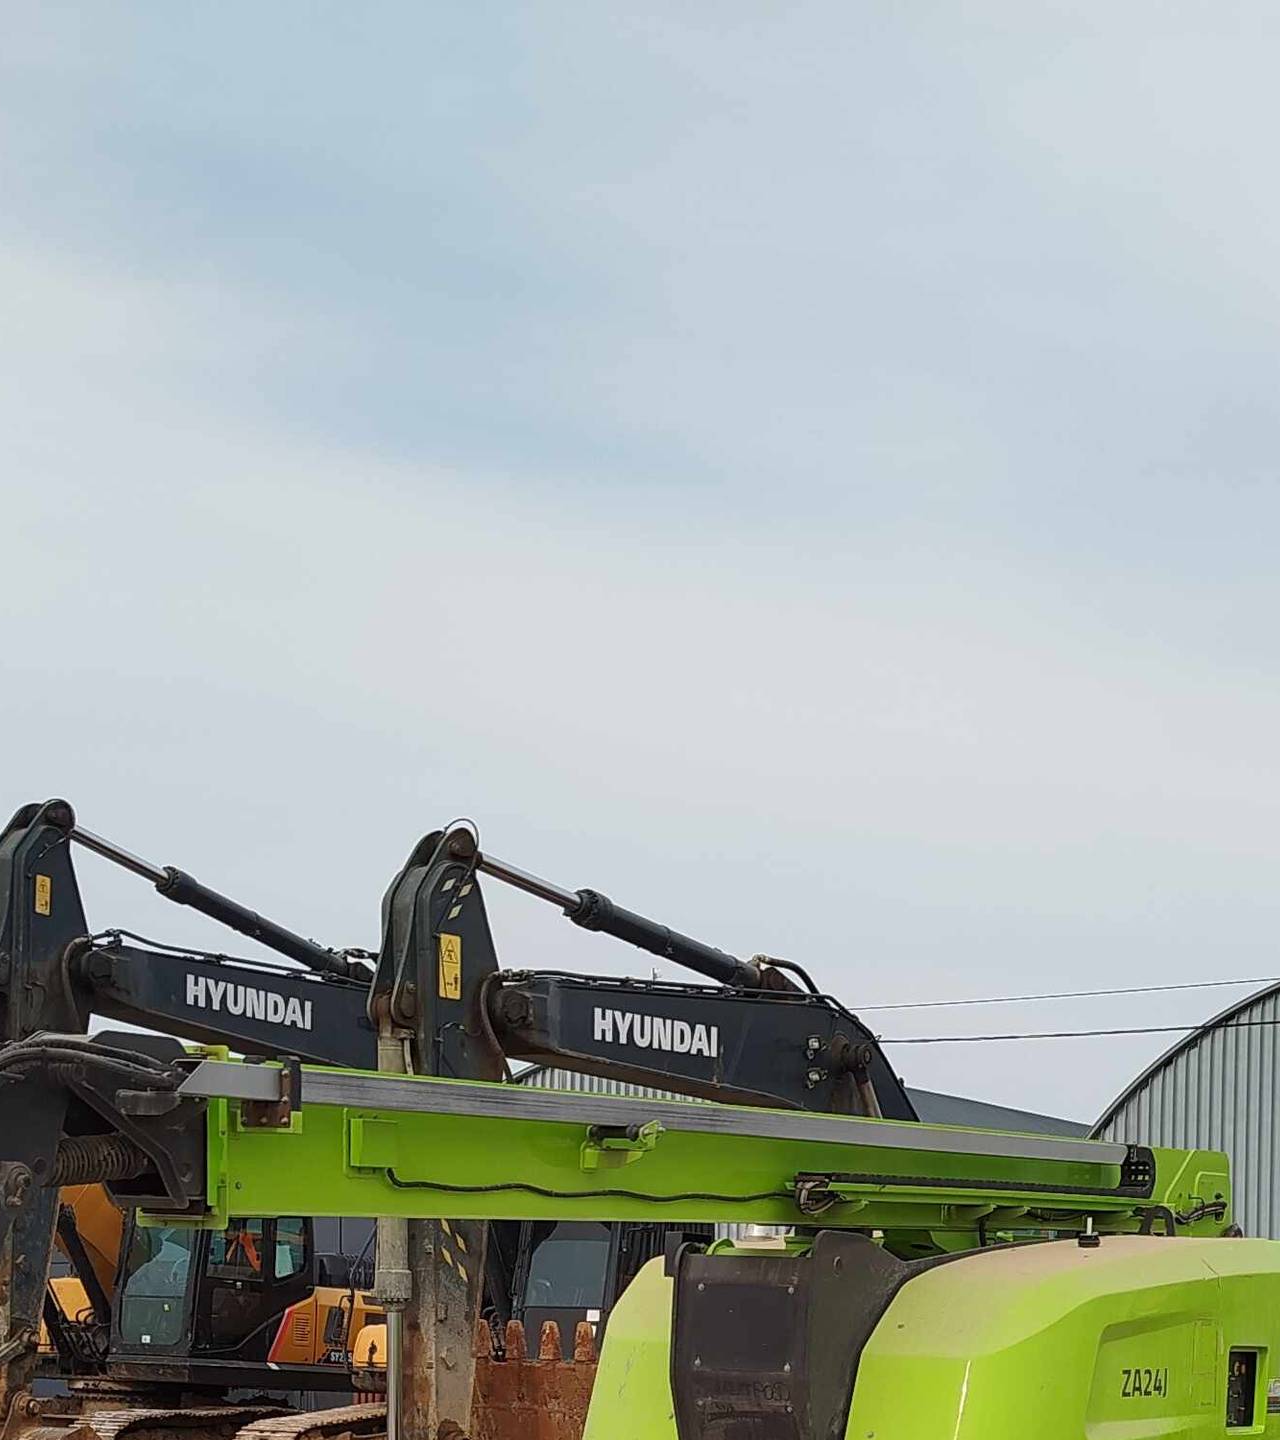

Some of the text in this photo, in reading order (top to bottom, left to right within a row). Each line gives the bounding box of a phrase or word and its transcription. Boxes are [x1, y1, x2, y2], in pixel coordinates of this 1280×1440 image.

[185, 973, 313, 1030] HYUNDAI
[593, 1006, 718, 1058] HYUNDAI
[330, 1351, 353, 1363] SY25
[1121, 1367, 1168, 1398] ZA24J
